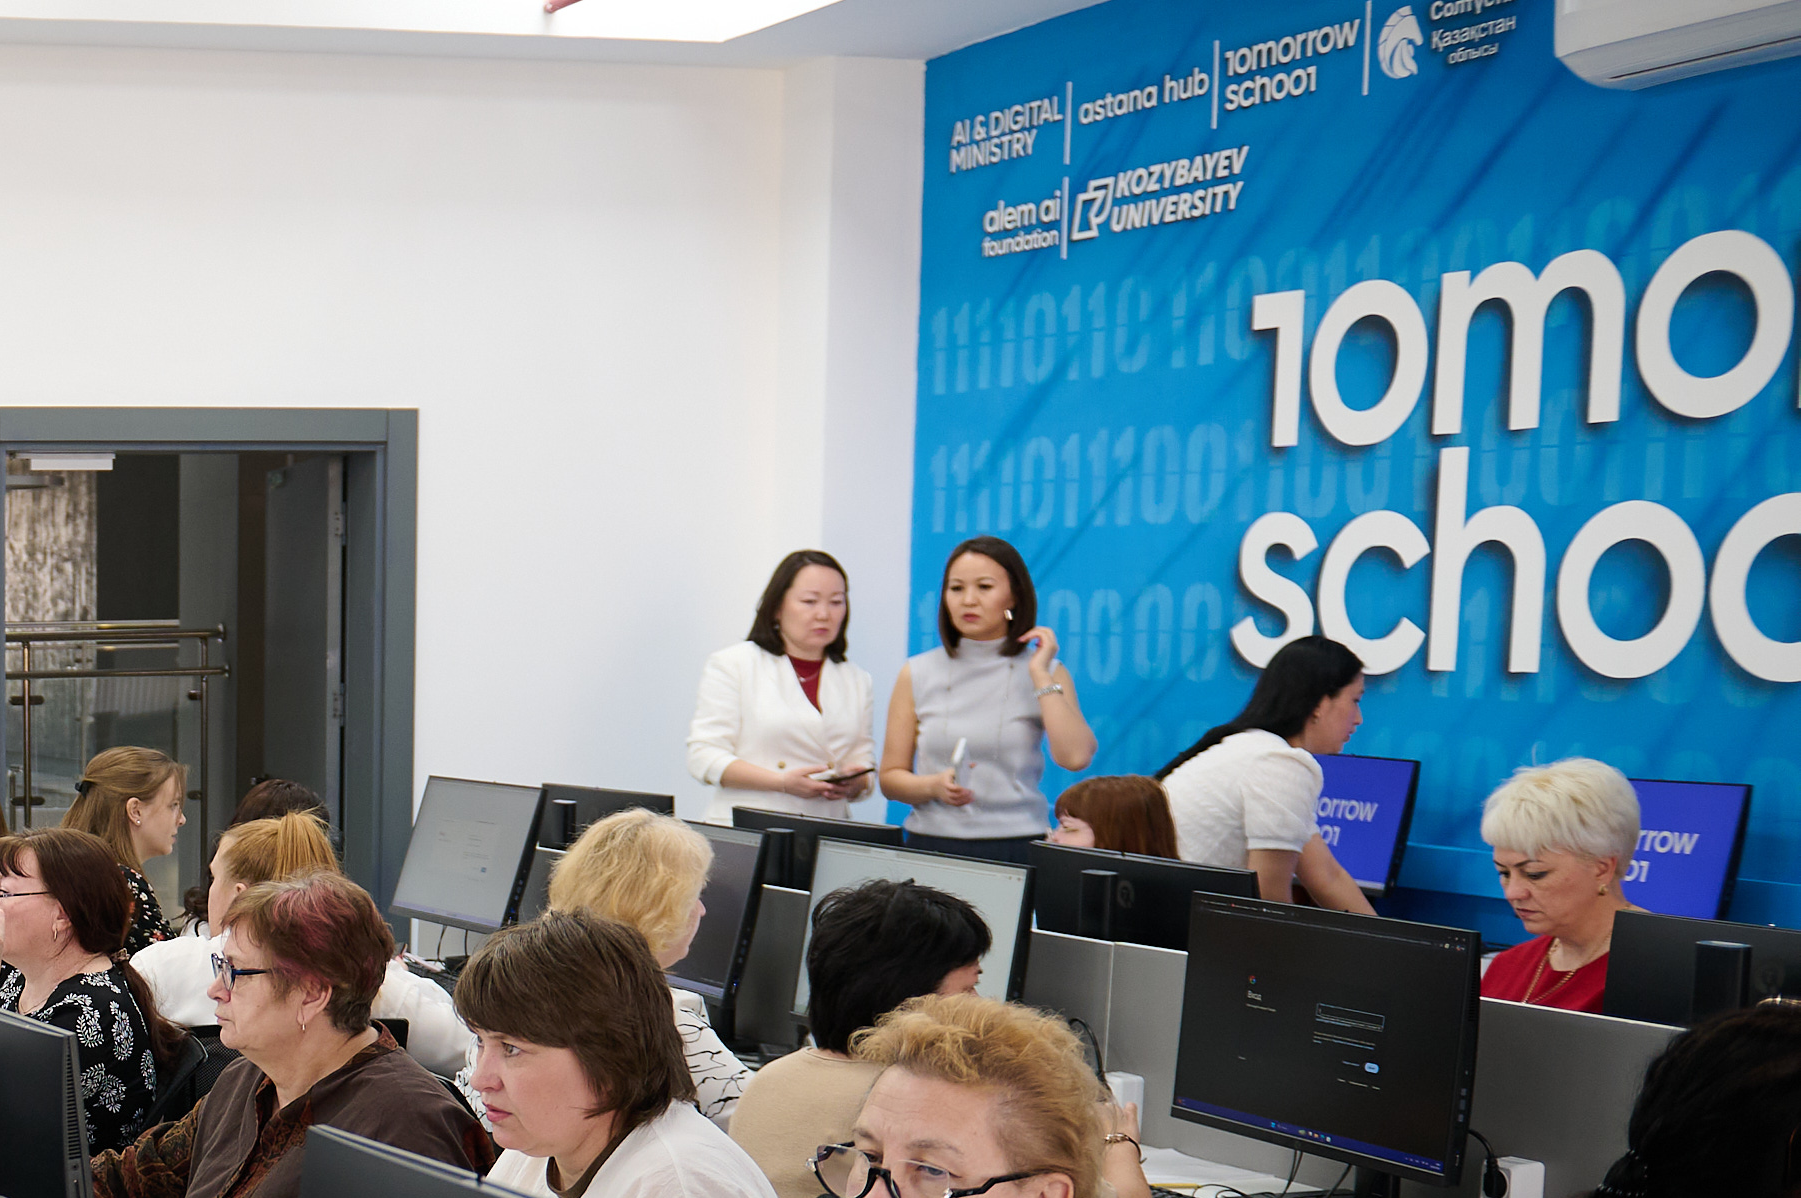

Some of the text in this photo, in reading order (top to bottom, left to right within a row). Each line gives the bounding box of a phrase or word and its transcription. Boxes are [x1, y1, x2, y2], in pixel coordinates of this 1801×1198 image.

[1431, 16, 1517, 52] Қазақстан
[1078, 67, 1210, 125] astana hub
[951, 95, 1064, 147] AI & DIGITAL
[950, 128, 1038, 174] MINISTRY
[1114, 145, 1250, 199] KOZYBAYEV
[983, 189, 1062, 234] alem ai
[1110, 180, 1245, 233] UNIVERSITY
[982, 228, 1060, 258] foundation
[1317, 796, 1379, 822] orrow
[1635, 829, 1700, 855] rrow
